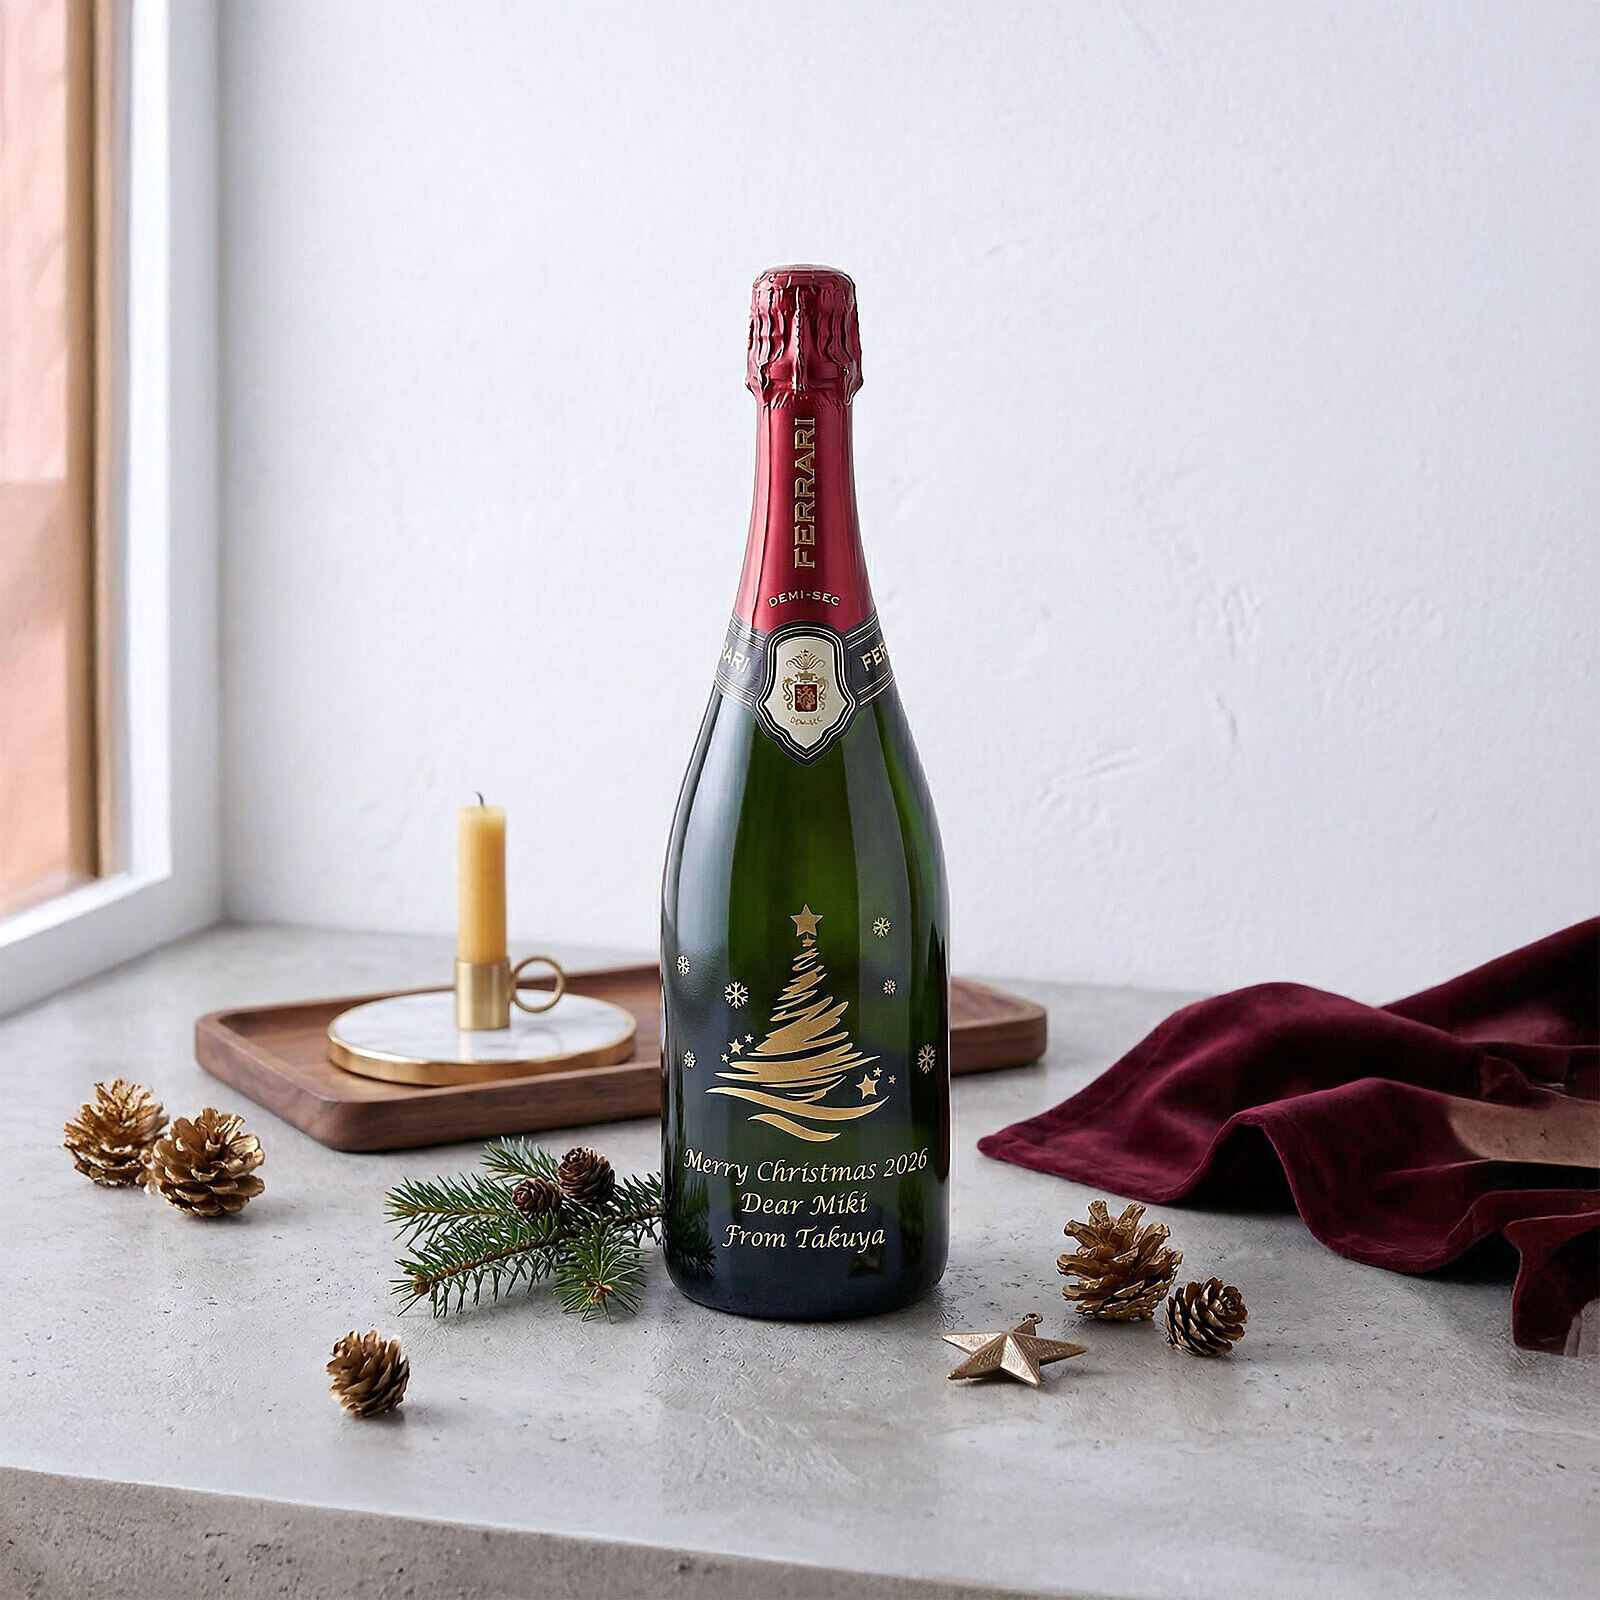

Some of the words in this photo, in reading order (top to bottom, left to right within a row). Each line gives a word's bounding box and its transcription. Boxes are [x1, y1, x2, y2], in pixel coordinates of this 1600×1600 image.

[794, 417, 815, 569] FERRARI
[768, 590, 841, 608] DEMI-SEC
[684, 1148, 749, 1186] Merry
[757, 1158, 877, 1183] Christmas
[882, 1147, 928, 1178] 2026
[740, 1192, 804, 1215] Dear
[809, 1190, 868, 1216] Miki
[721, 1224, 787, 1248] From
[795, 1224, 886, 1253] Takuya
